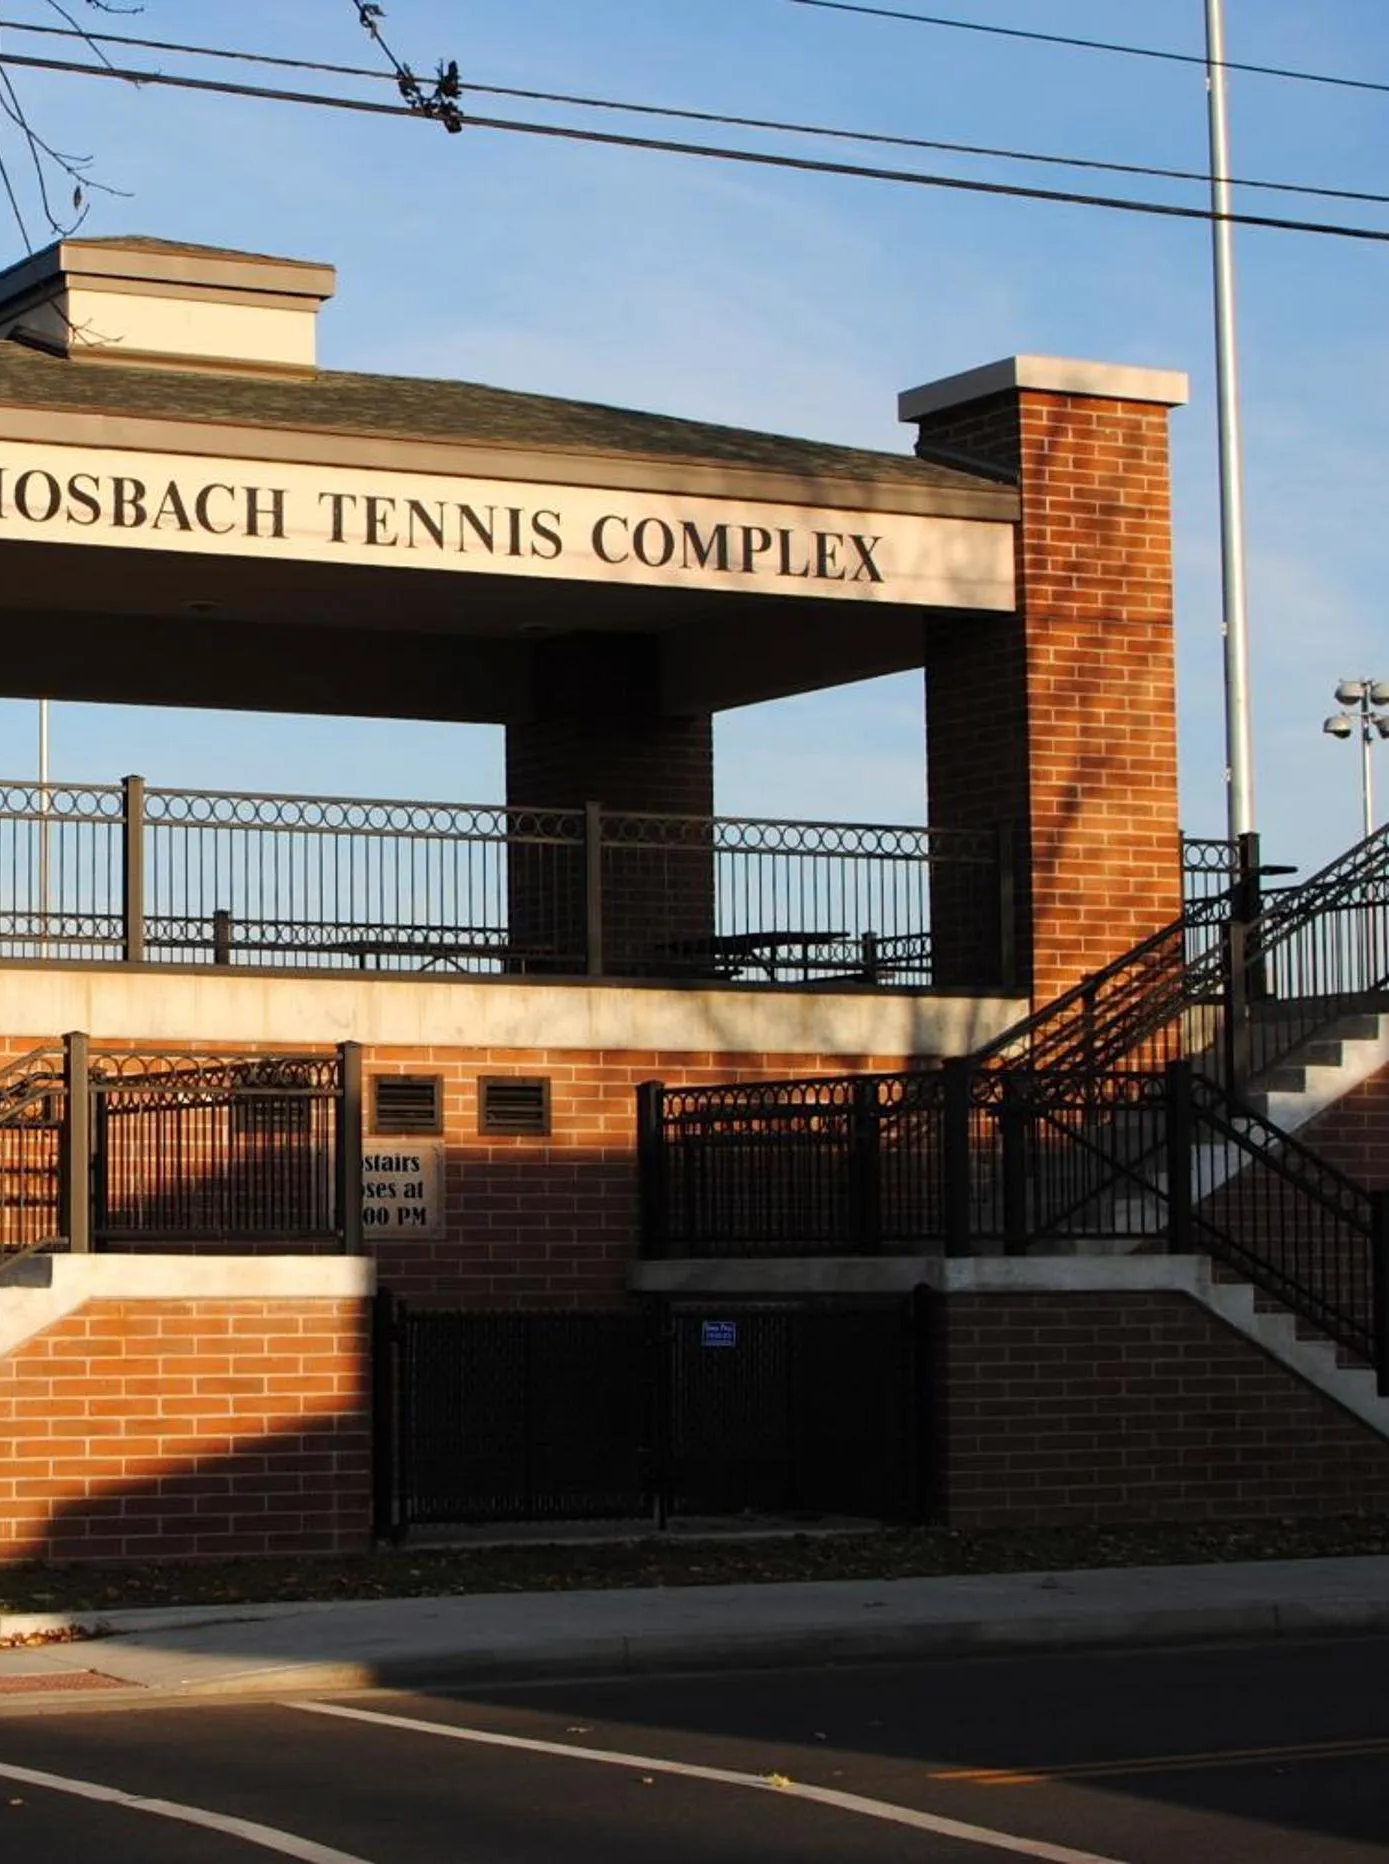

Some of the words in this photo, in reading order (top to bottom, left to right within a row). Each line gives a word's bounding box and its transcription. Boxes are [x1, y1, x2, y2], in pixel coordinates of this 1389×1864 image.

[318, 492, 563, 559] TENNIS
[591, 515, 886, 583] COMPLEX
[403, 1180, 424, 1199] at
[397, 1206, 427, 1226] PM
